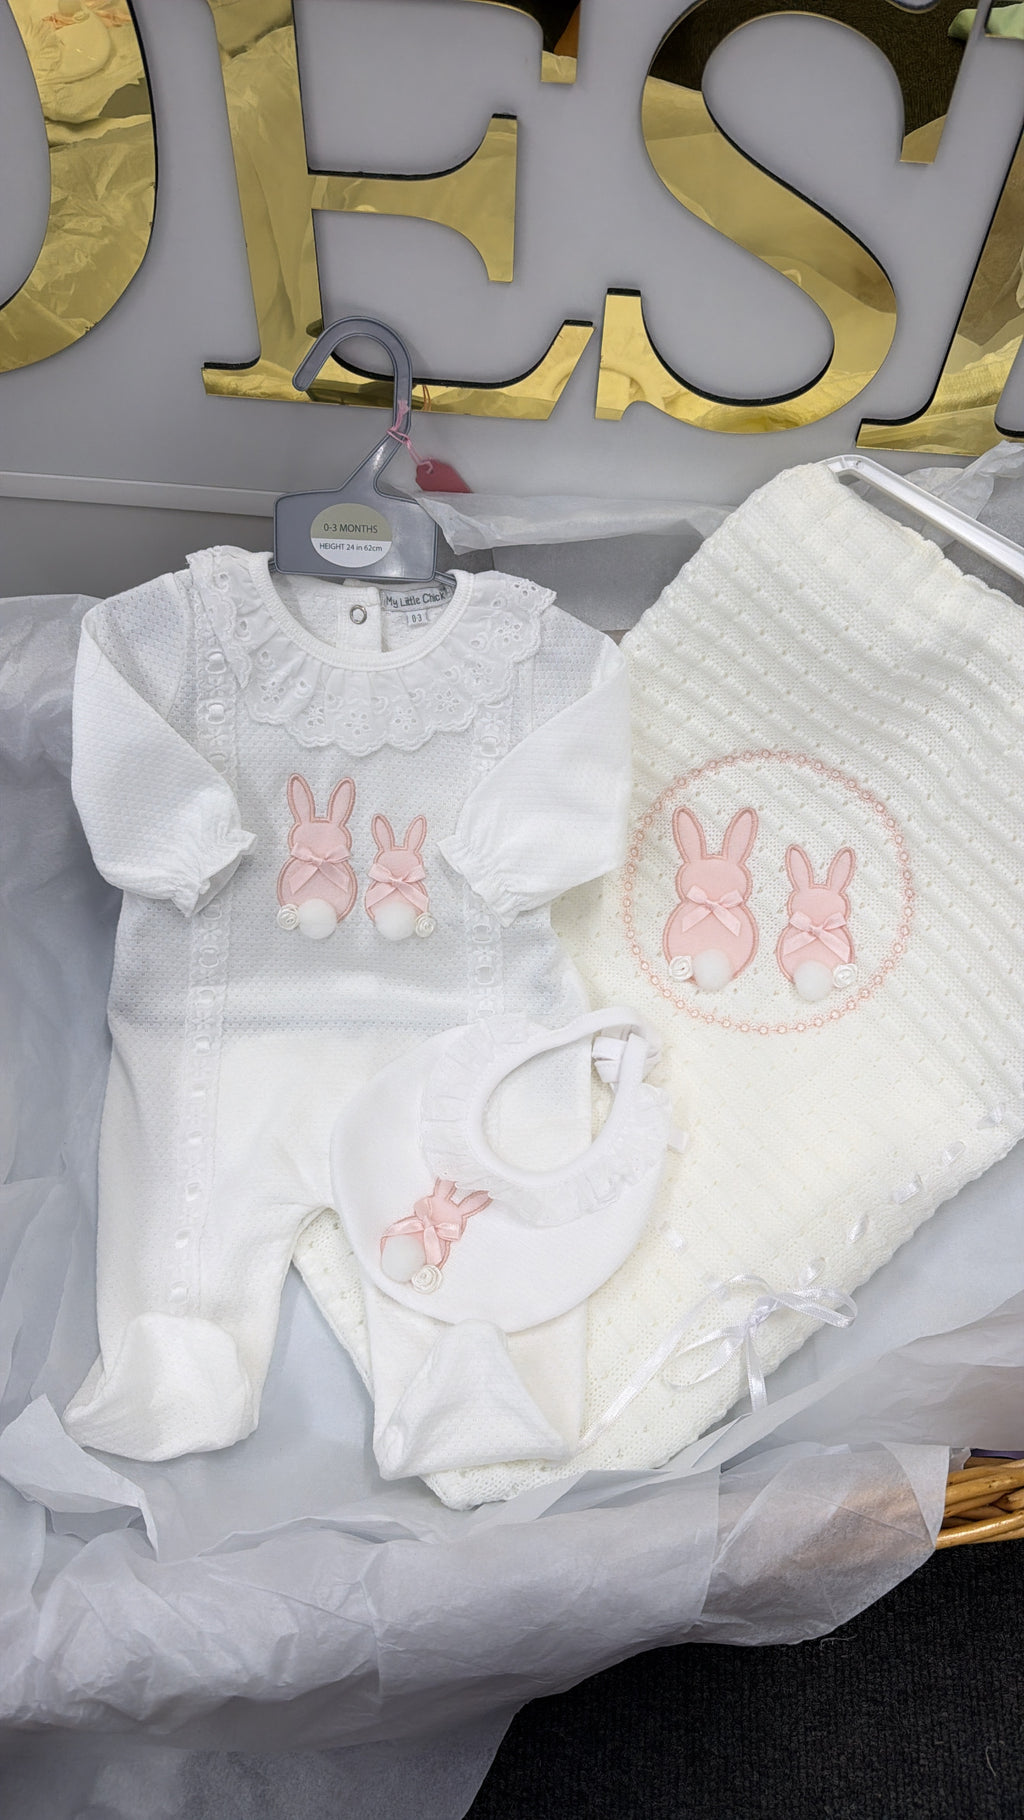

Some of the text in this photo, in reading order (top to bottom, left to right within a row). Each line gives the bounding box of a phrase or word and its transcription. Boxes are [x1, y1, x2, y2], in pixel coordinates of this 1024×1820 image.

[323, 523, 378, 534] 0-3 MONTHS
[319, 543, 345, 551] HEIGHT
[346, 543, 355, 551] 24
[364, 544, 383, 552] 62cm
[386, 595, 399, 608] My
[399, 595, 421, 607] Little
